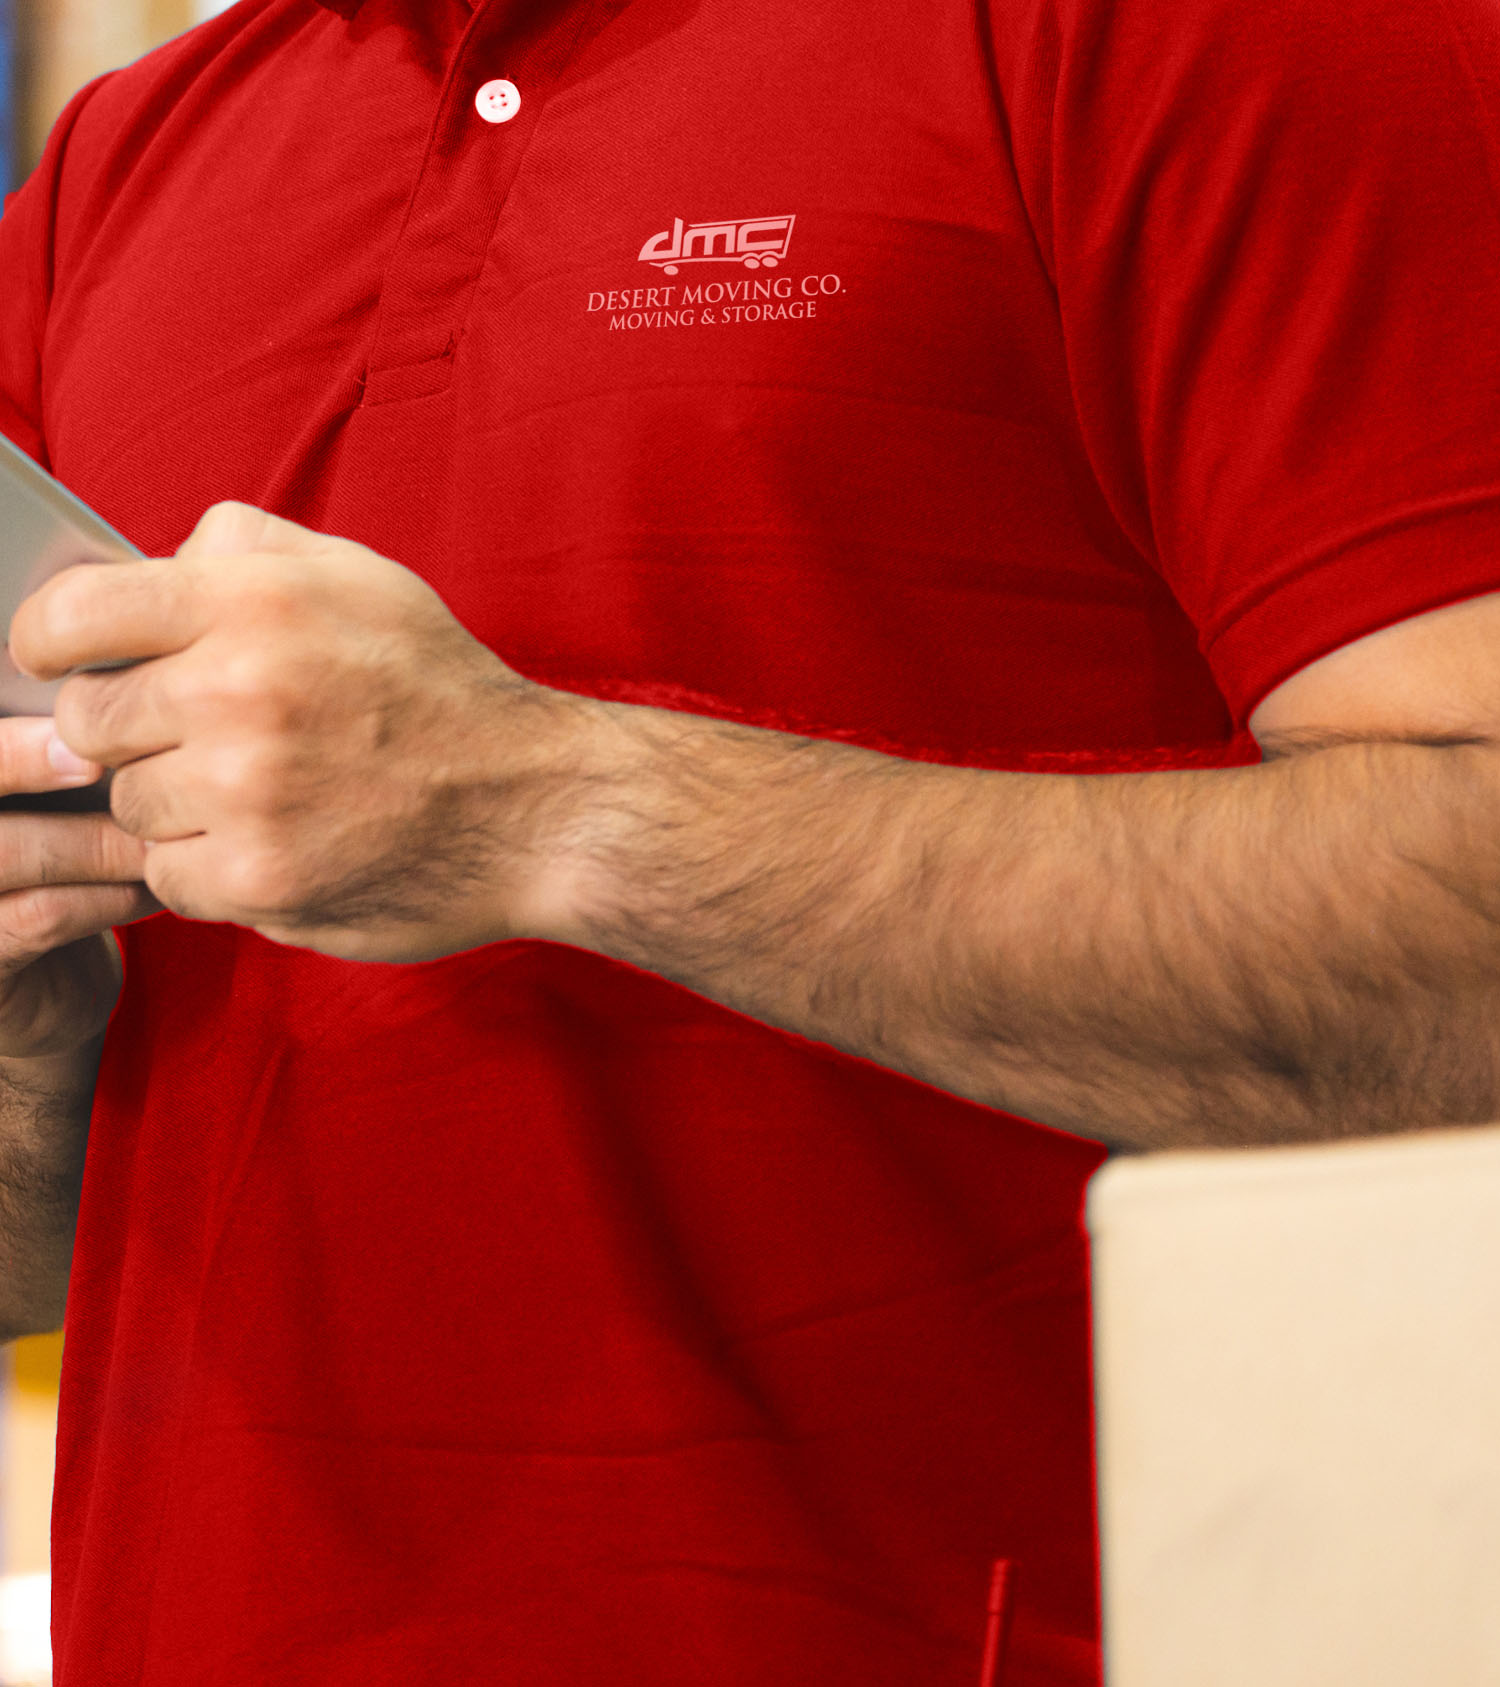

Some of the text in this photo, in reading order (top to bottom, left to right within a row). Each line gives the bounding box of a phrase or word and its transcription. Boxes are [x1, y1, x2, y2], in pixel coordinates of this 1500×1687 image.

[587, 274, 847, 312] DESERT MOVING CO.
[609, 301, 817, 331] MOVING & STORAGE
